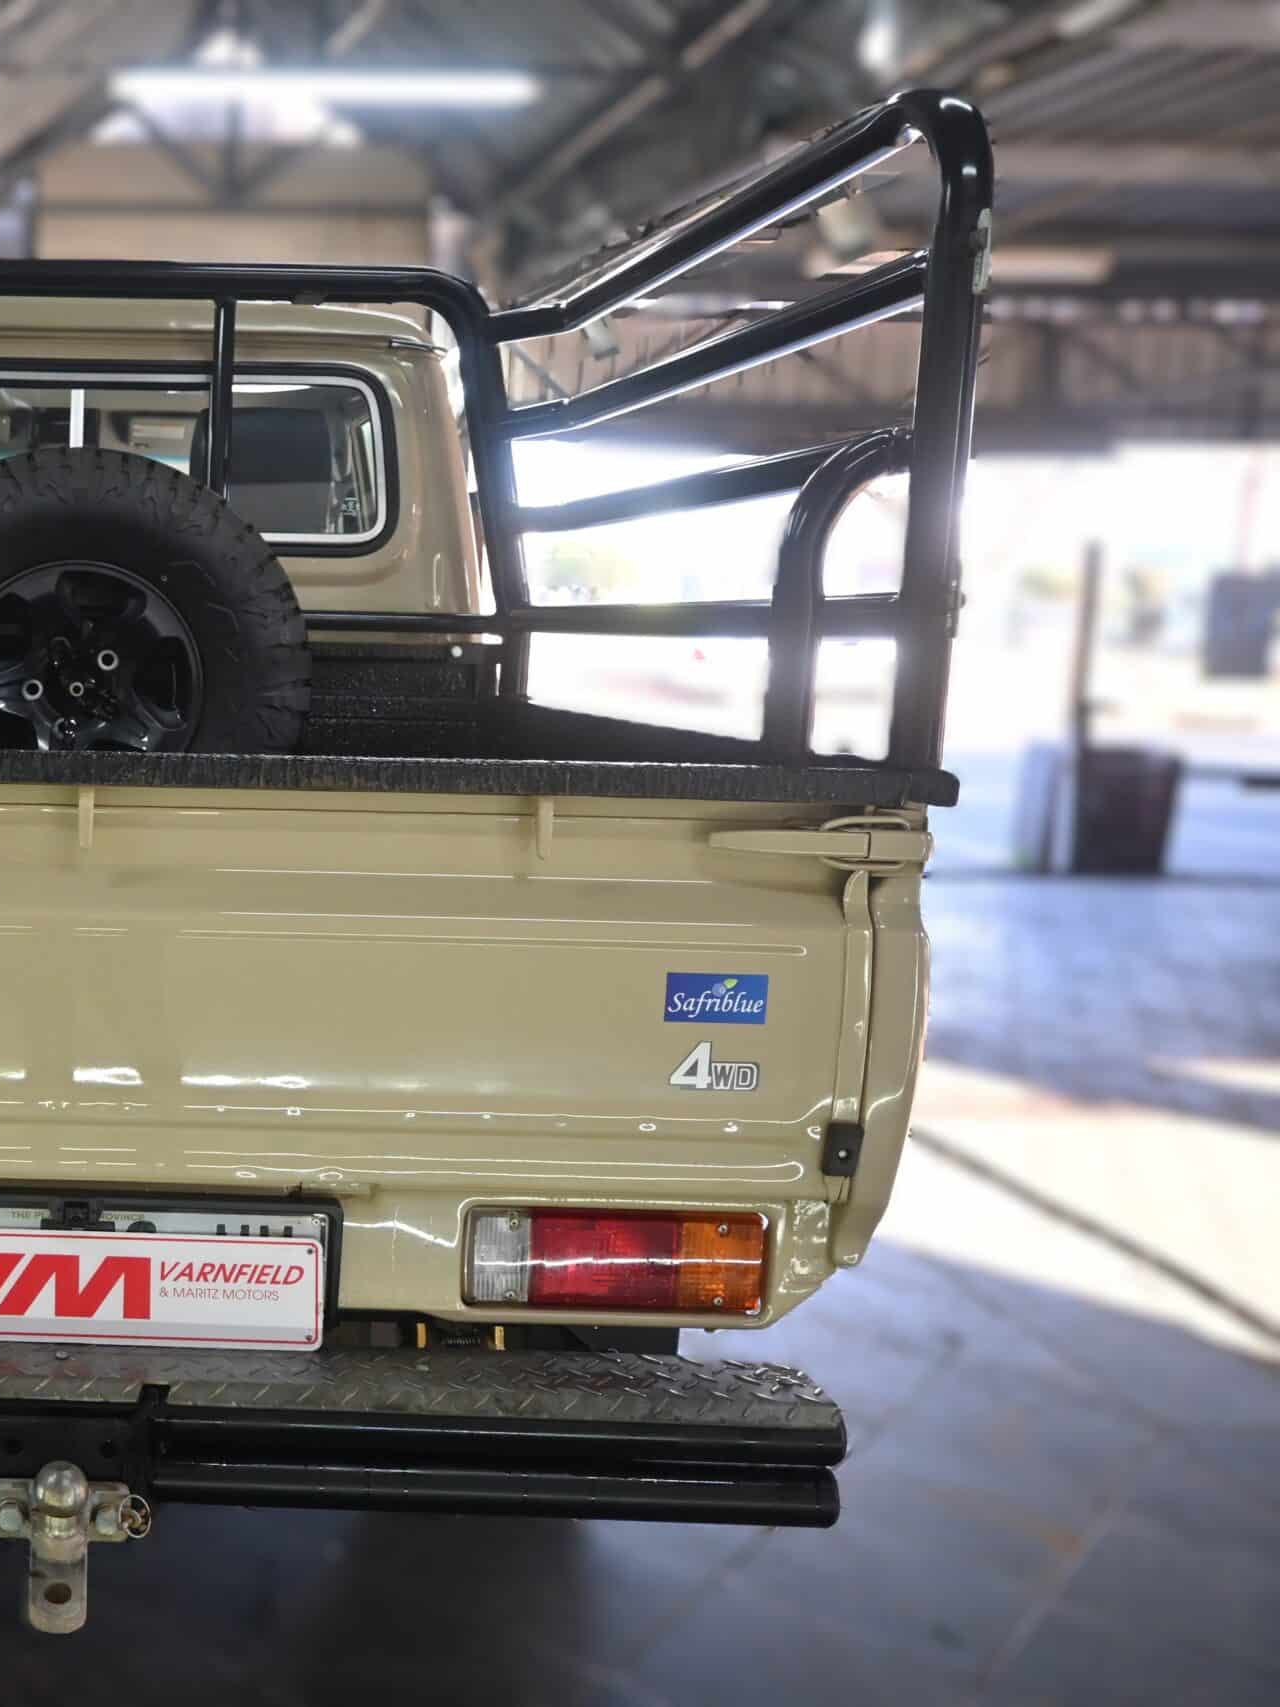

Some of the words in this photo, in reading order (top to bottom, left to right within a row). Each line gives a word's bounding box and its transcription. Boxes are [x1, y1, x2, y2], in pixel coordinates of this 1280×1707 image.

[667, 990, 764, 1018] Safriblue
[670, 1040, 760, 1091] 4WD
[159, 1261, 305, 1285] VARNFIELD
[159, 1287, 169, 1298] &
[173, 1287, 218, 1300] MARITZ
[222, 1288, 280, 1301] MOTORS
